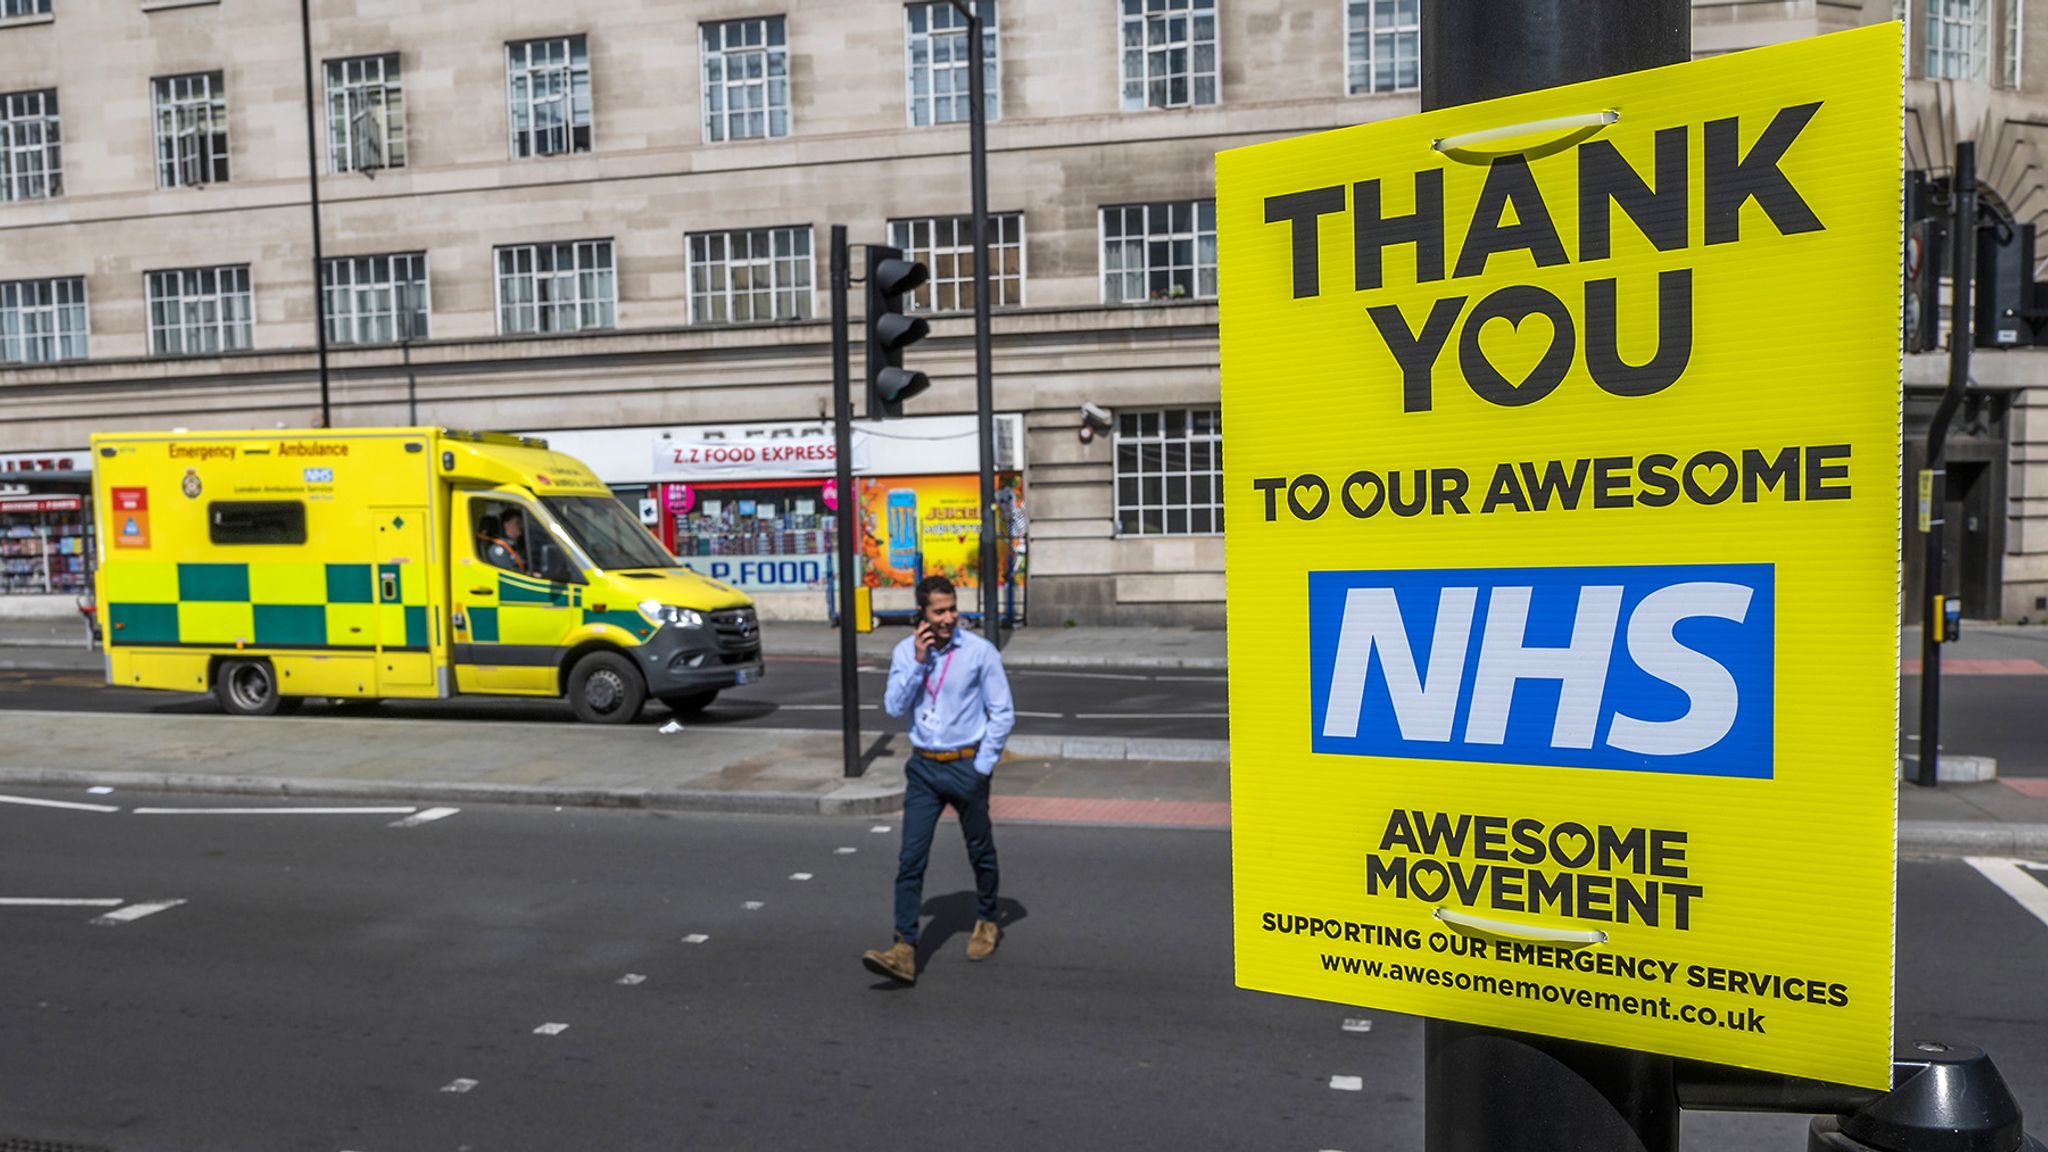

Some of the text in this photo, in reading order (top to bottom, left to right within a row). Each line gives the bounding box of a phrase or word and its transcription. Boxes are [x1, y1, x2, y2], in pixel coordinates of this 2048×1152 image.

[1263, 101, 1827, 299] THANK
[1366, 268, 1693, 413] YOU
[168, 442, 349, 460] Emergency Ambulance
[673, 445, 837, 464] Z.Z FOOD EXPRESS
[1254, 443, 1851, 522] TO OUR AWESOME
[1323, 582, 1754, 755] NHS
[1379, 809, 1688, 879] AWESOME
[1366, 854, 1703, 931] MOVEMENT
[1262, 911, 1849, 1008] SUPPORTING OUR EMERGENCY SERVICES
[1320, 954, 1766, 1034] www.awesomemovement.co.uk
